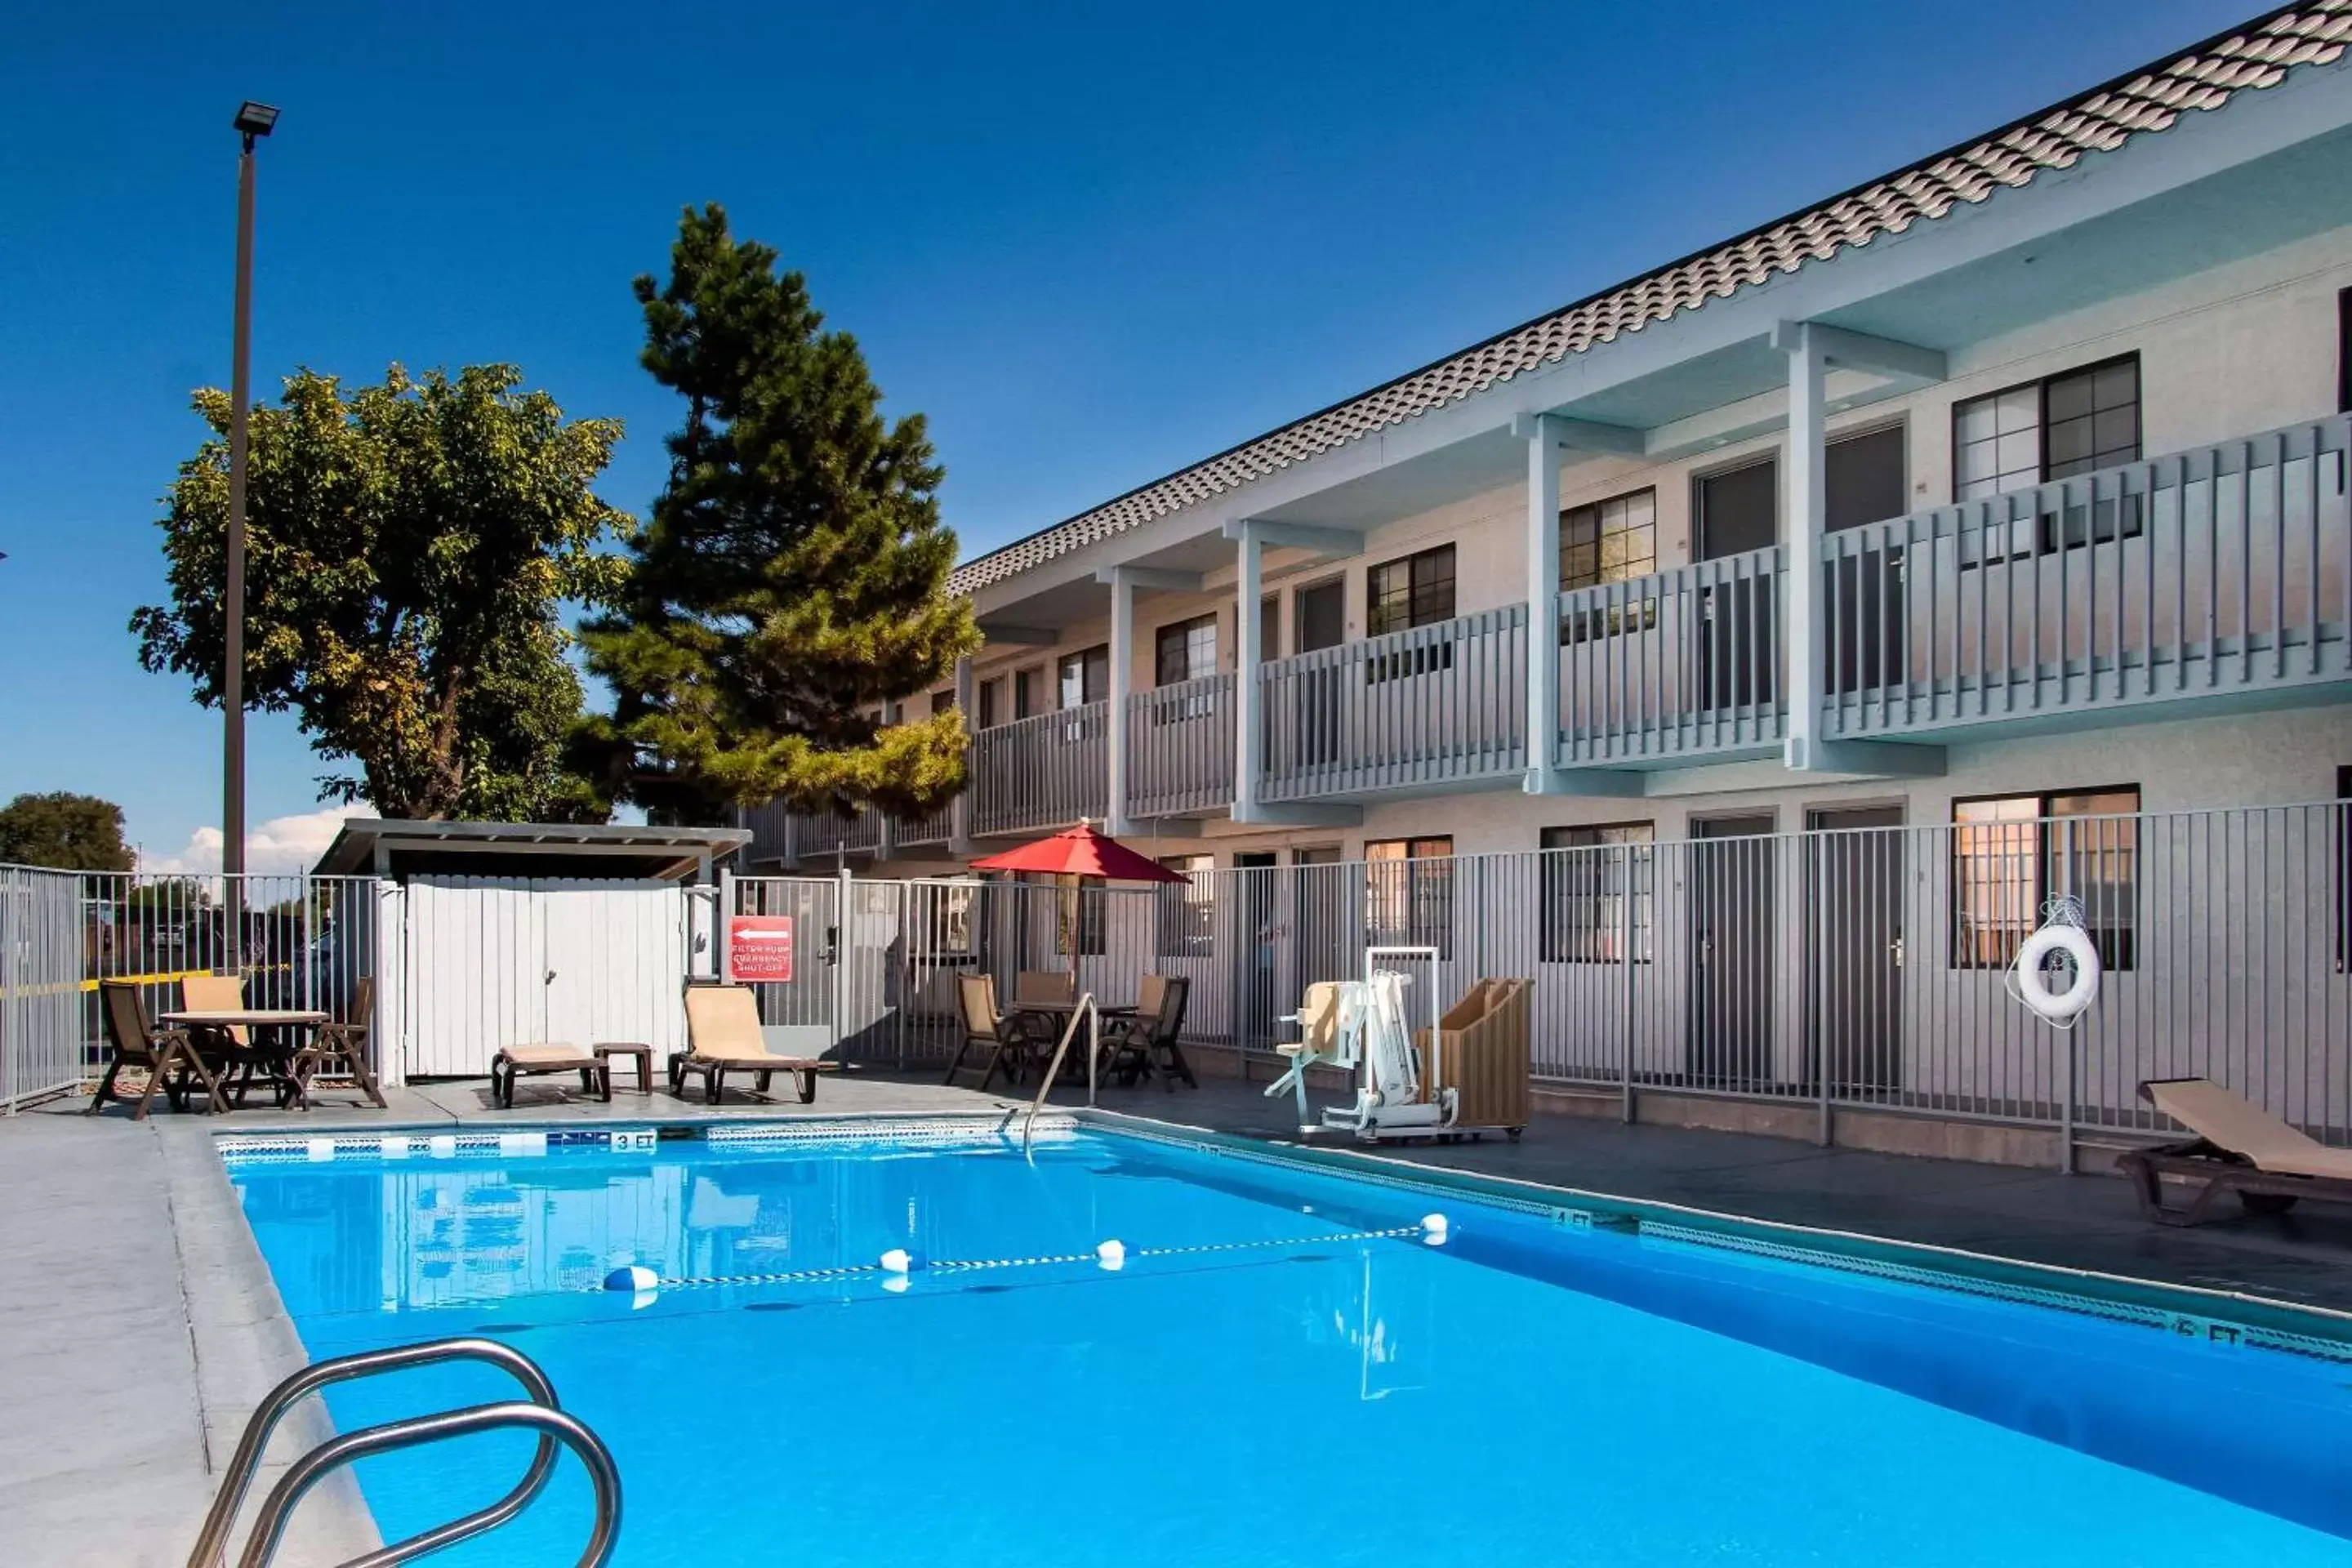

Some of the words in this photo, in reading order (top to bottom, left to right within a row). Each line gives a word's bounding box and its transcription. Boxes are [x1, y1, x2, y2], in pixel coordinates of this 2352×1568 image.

[617, 1134, 628, 1150] 3
[636, 1134, 653, 1149] FT
[2209, 1325, 2240, 1345] FT
